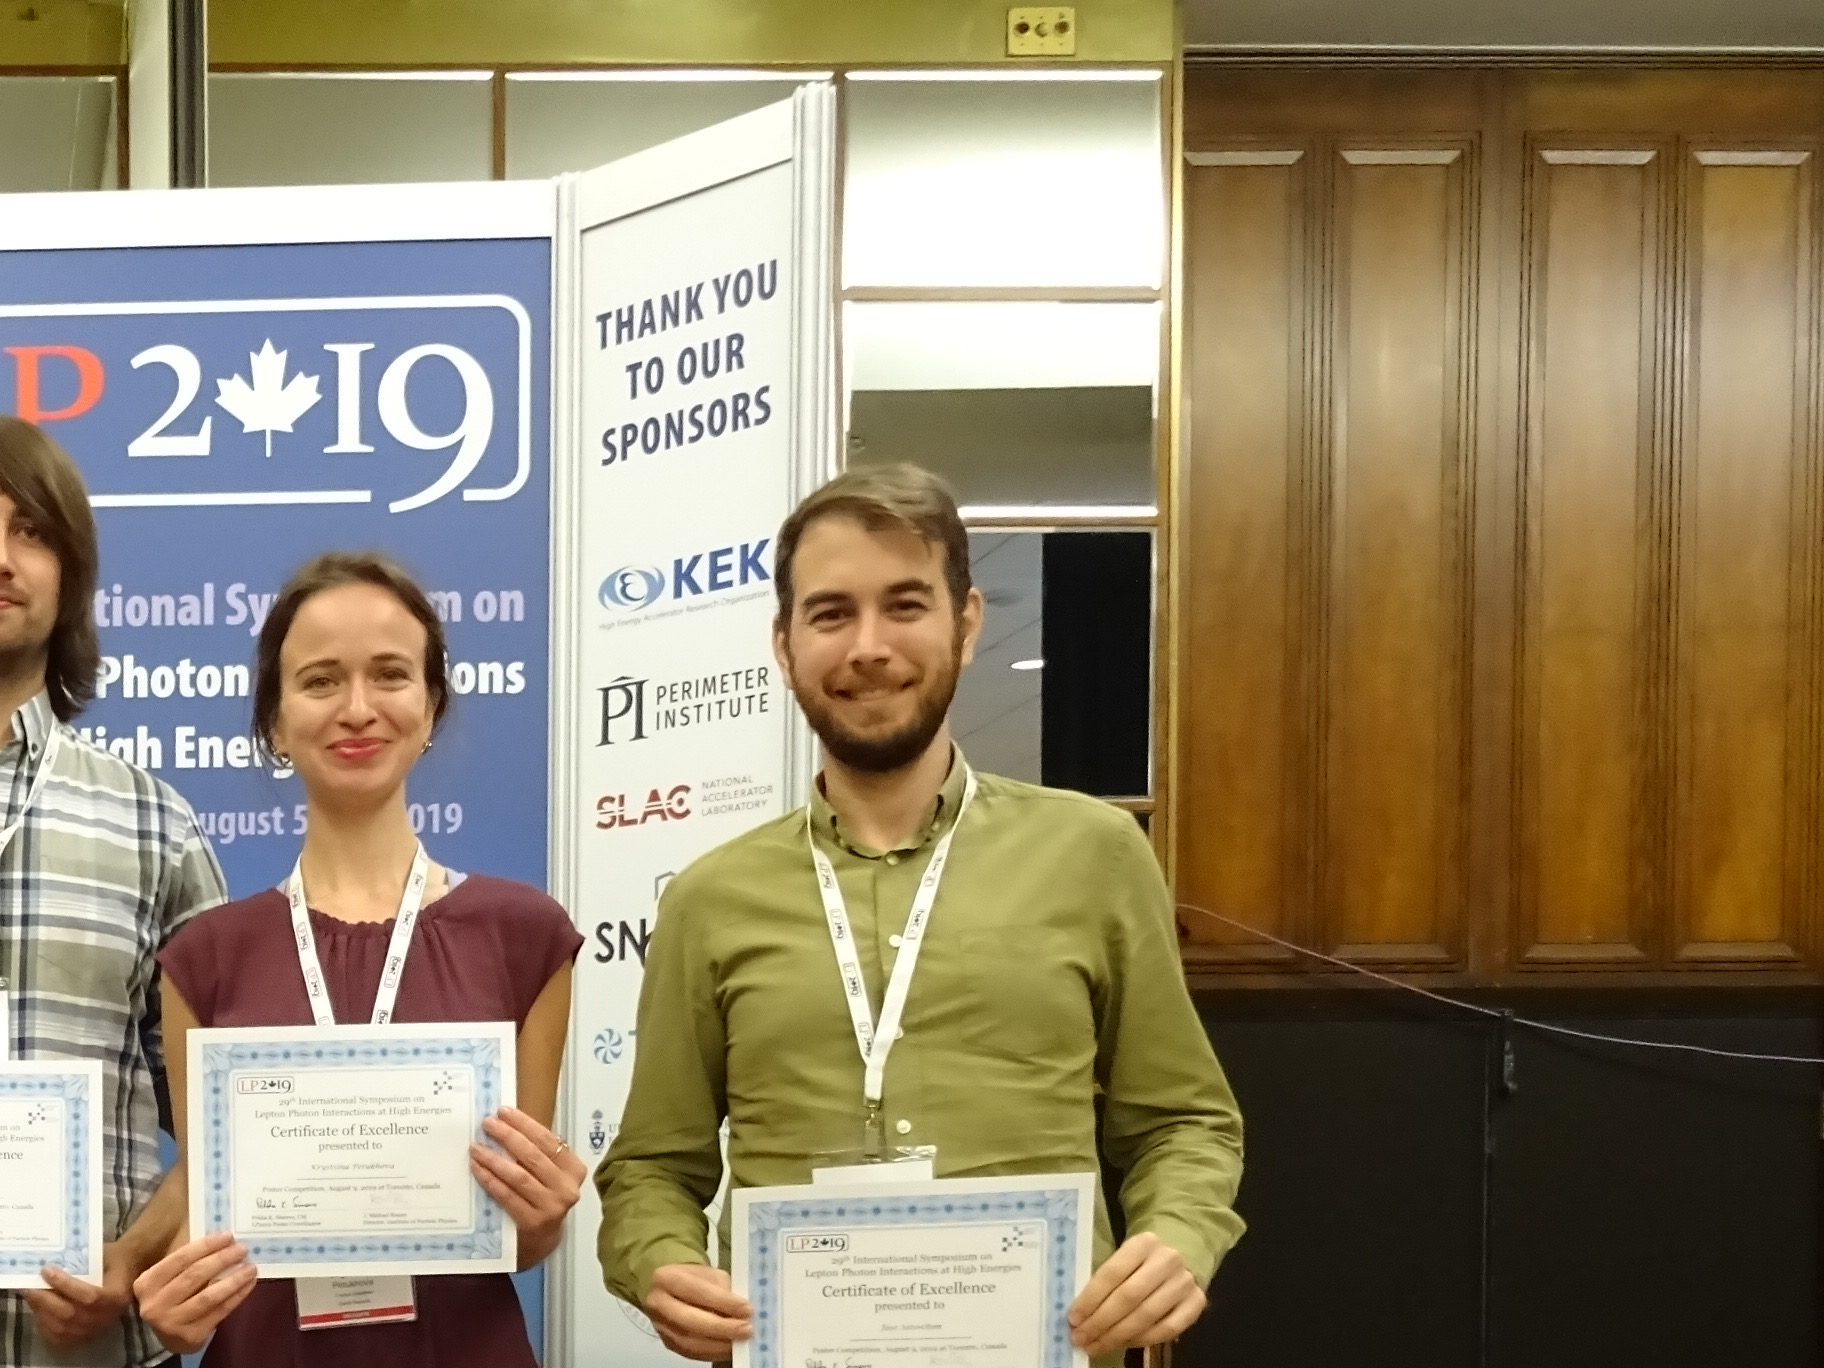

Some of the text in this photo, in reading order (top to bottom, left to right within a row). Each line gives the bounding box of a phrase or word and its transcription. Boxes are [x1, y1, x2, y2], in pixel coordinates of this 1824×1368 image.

[596, 259, 778, 351] THANK YOU
[625, 332, 744, 400] TO OUR
[600, 385, 771, 467] SPONSORS
[673, 538, 771, 600] KEK
[473, 590, 524, 622] on
[95, 654, 250, 698] Photon
[656, 666, 769, 706] PERIMETER
[656, 692, 769, 731] INSTITUTE
[701, 775, 753, 790] NATIONAL
[701, 786, 774, 803] ACCELERATOR
[596, 785, 692, 831] SLAC
[701, 799, 768, 817] LABORATORY
[594, 919, 653, 967] SN
[255, 1110, 285, 1119] Lepton
[288, 1108, 319, 1118] Photon
[322, 1108, 375, 1117] Interactions
[389, 1107, 410, 1117] High
[413, 1106, 452, 1116] Energies
[271, 1122, 429, 1138] Certificate of Excellence
[318, 1141, 382, 1153] presented to
[822, 1281, 996, 1298] Certificate of Excellence
[874, 1300, 945, 1314] presented to
